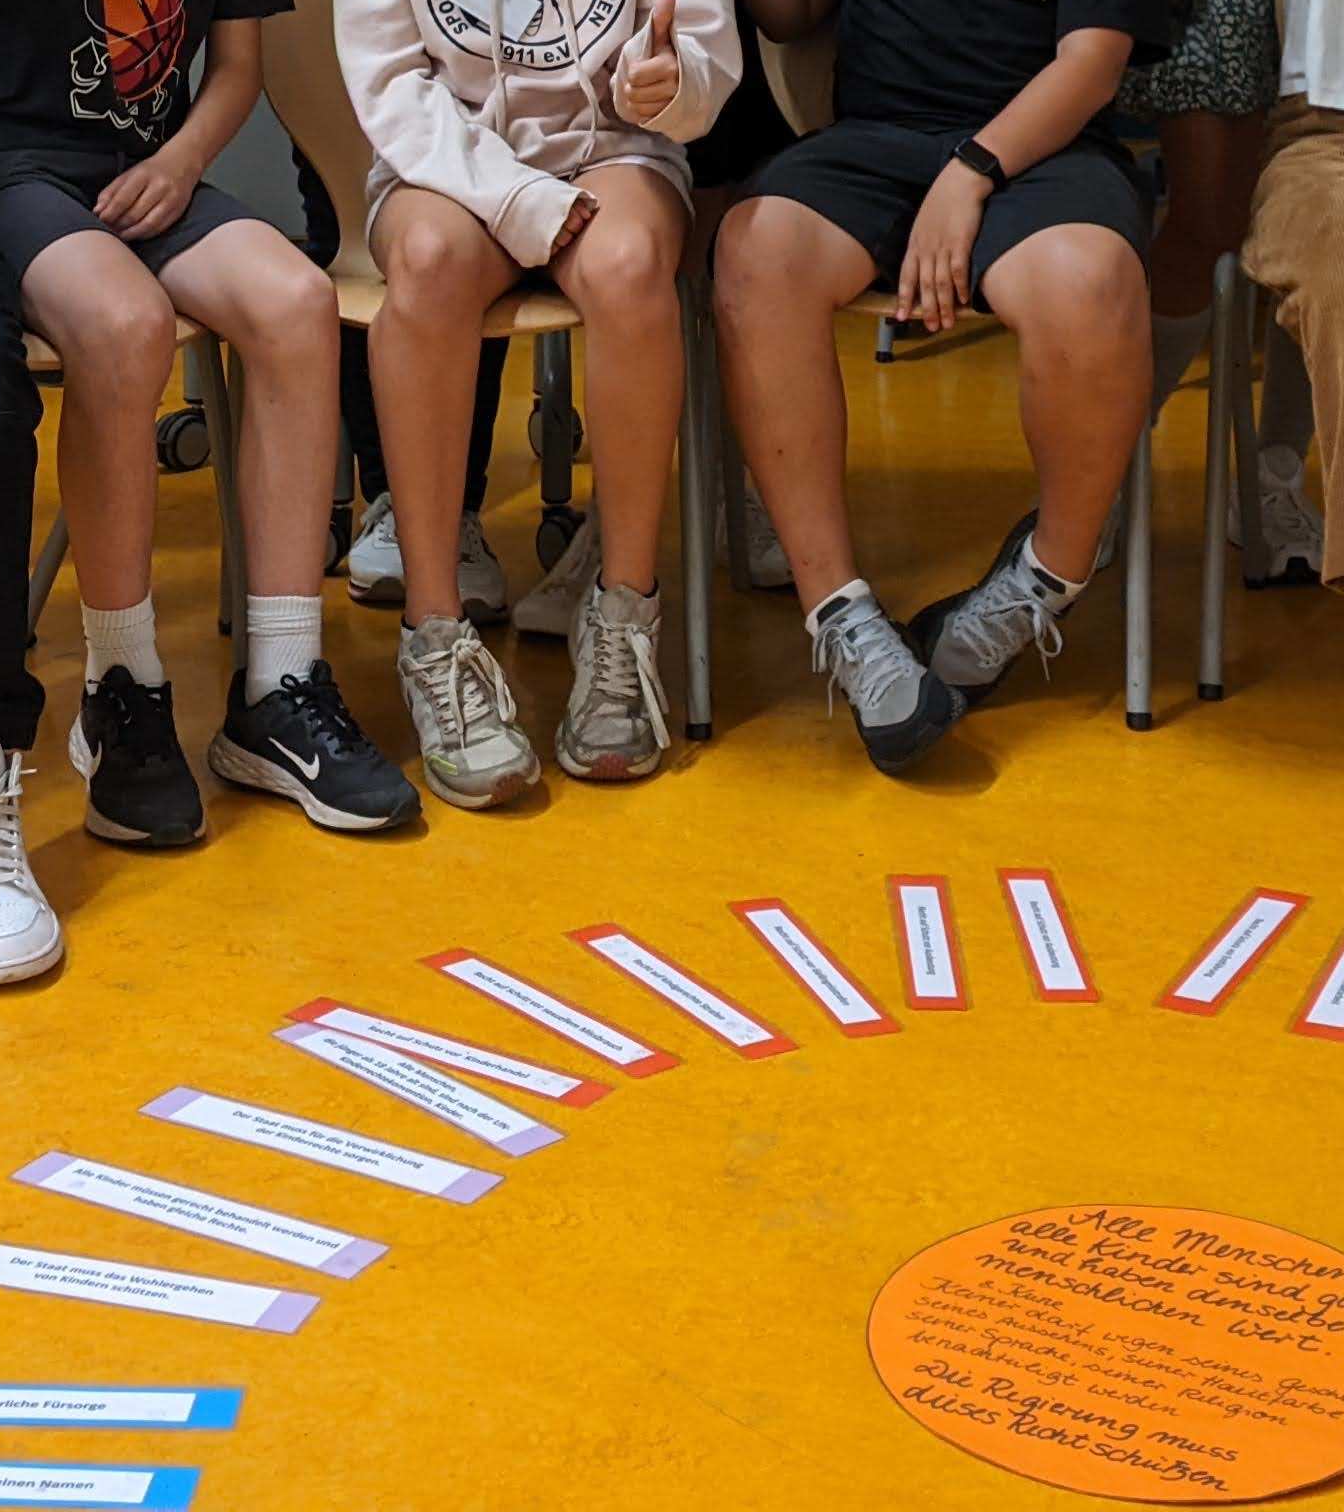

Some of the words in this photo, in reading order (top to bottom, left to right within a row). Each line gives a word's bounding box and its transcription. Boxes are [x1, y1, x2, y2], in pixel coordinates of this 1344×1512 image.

[367, 1025, 396, 1037] Recht
[394, 1033, 414, 1042] auf
[443, 1048, 463, 1057] vor
[463, 1055, 530, 1078] Kinderhandel
[395, 1061, 417, 1071] Alle
[322, 1037, 338, 1045] die
[455, 1101, 478, 1113] nach
[476, 1111, 494, 1121] der
[231, 1109, 253, 1119] Der
[251, 1115, 280, 1127] Staat
[279, 1123, 308, 1135] muss
[307, 1130, 326, 1139] für
[325, 1135, 344, 1145] die
[344, 1140, 424, 1169] Verwirklichung
[254, 1126, 275, 1135] der
[274, 1131, 342, 1154] Kinderrechte
[71, 1168, 95, 1177] Alle
[94, 1173, 130, 1188] Kinder
[129, 1184, 172, 1200] müssen
[170, 1196, 215, 1213] gerecht
[213, 1208, 271, 1229] behandelt
[271, 1225, 315, 1242] werden
[314, 1238, 341, 1249] und
[132, 1195, 168, 1209] haben
[165, 1205, 207, 1222] gleiche
[1068, 1209, 1156, 1243] Alle
[9, 1256, 33, 1266] Der
[34, 1260, 68, 1272] Staat
[68, 1266, 102, 1277] muss
[103, 1271, 126, 1281] das
[129, 1274, 214, 1295] Wohlergehen
[1002, 1238, 1076, 1266] und
[1078, 1257, 1174, 1293] haben
[1009, 1220, 1078, 1246] alle
[1088, 1237, 1207, 1276] Kinder
[1215, 1270, 1311, 1302] sind
[33, 1272, 58, 1281] von
[58, 1274, 109, 1289] Kindern
[110, 1284, 168, 1299] schützen.
[976, 1253, 1205, 1326] menschlichen
[920, 1276, 1021, 1309] Keiner
[1025, 1309, 1096, 1336] darf
[1102, 1331, 1176, 1357] wegen
[42, 1400, 106, 1411] Fürsorge
[902, 1384, 1001, 1425] dieses
[1007, 1406, 1089, 1449] Recht
[913, 1359, 973, 1388] Die
[981, 1377, 1140, 1440] Regierung
[1146, 1431, 1239, 1461] muss
[1087, 1384, 1182, 1417] werden
[1178, 1388, 1288, 1427] Religion
[38, 1479, 94, 1489] Namen
